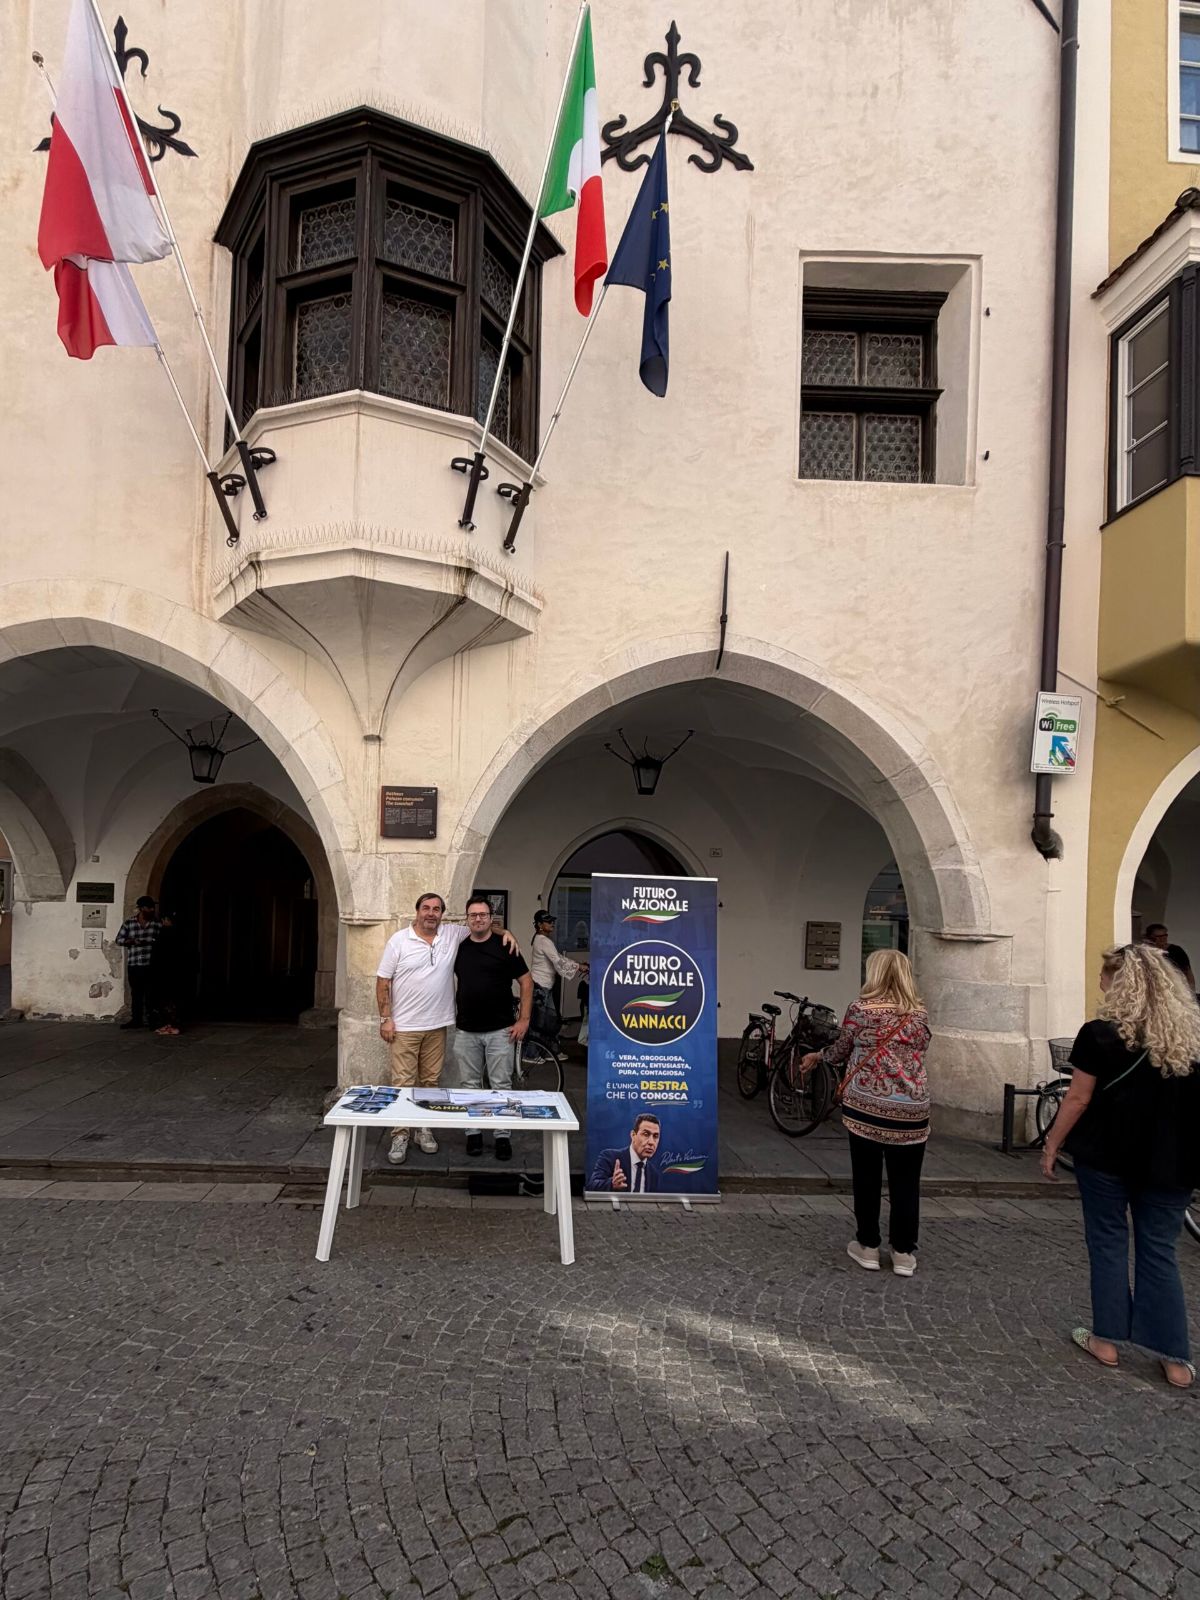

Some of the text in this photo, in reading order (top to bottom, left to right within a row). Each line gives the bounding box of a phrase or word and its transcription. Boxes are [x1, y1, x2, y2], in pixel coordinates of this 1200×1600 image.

[1041, 720, 1075, 731] Wi Free
[633, 886, 677, 900] FUTURO
[621, 898, 689, 912] NAZIONALE
[626, 954, 681, 971] FUTURO
[613, 970, 694, 987] NAZIONALE
[621, 1013, 687, 1030] VANNACCI
[618, 1054, 639, 1062] VERA,
[612, 1061, 648, 1069] CONVINTA,
[606, 1080, 689, 1091] È L'UNICA DESTRA
[606, 1091, 688, 1101] CHE IO CONOSCA
